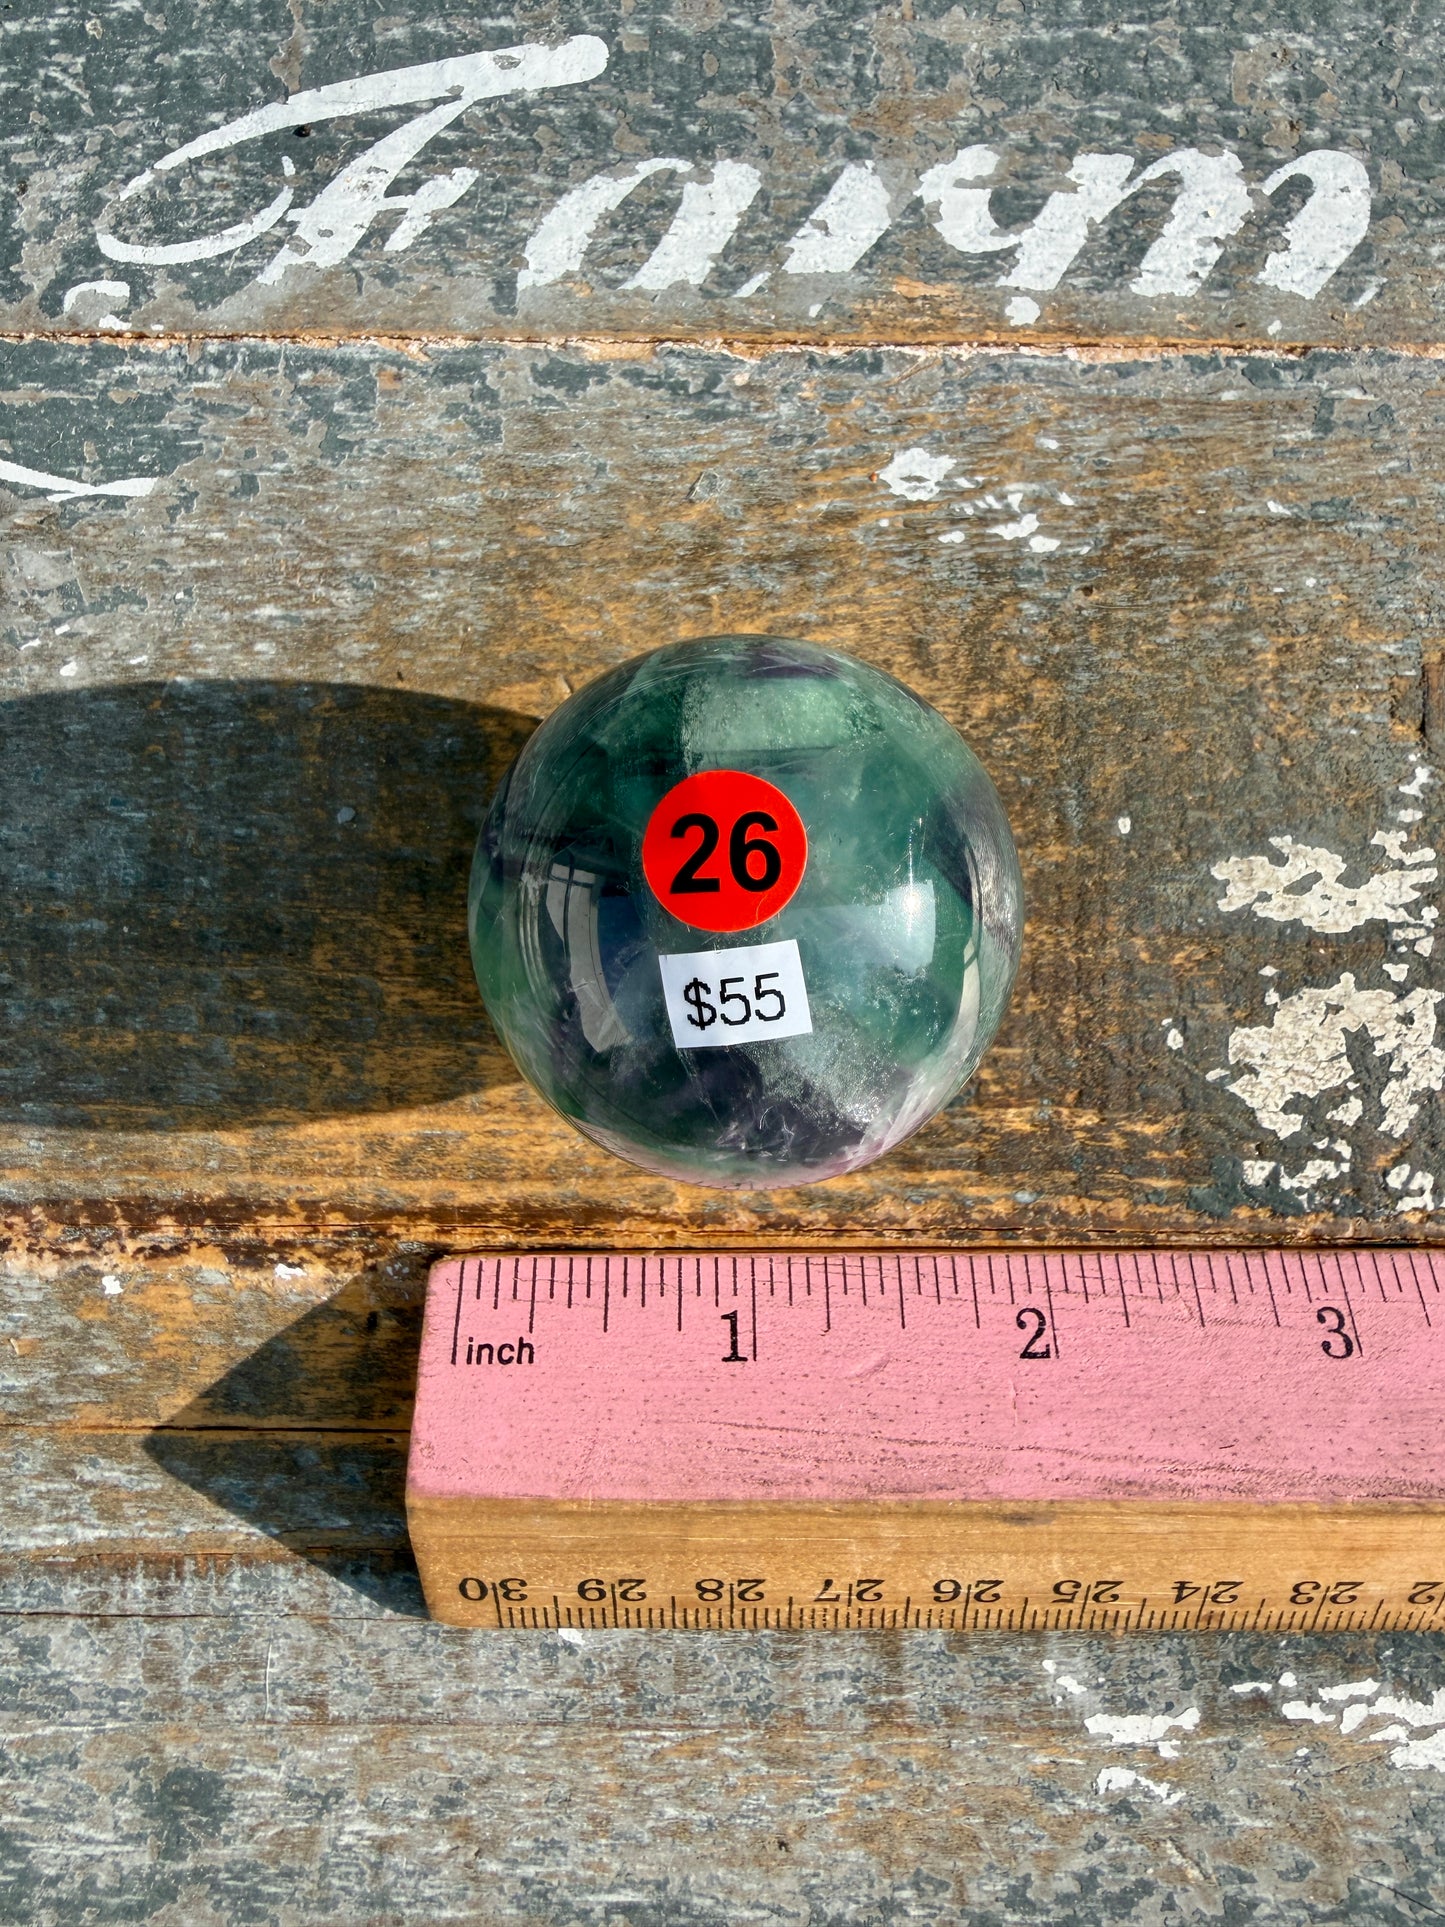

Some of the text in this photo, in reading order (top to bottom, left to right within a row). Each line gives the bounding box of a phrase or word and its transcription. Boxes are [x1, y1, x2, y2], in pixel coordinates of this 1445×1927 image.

[669, 810, 782, 894] 26
[683, 972, 787, 1030] $55
[465, 1306, 1355, 1366] inch 1 2 3
[458, 1577, 528, 1602] 30
[577, 1577, 648, 1602] 29
[695, 1578, 766, 1602] 28
[813, 1578, 885, 1602] 27
[932, 1578, 1004, 1603] 26
[1052, 1579, 1125, 1604] 25
[1171, 1580, 1245, 1604] 24
[1289, 1580, 1365, 1605] 23
